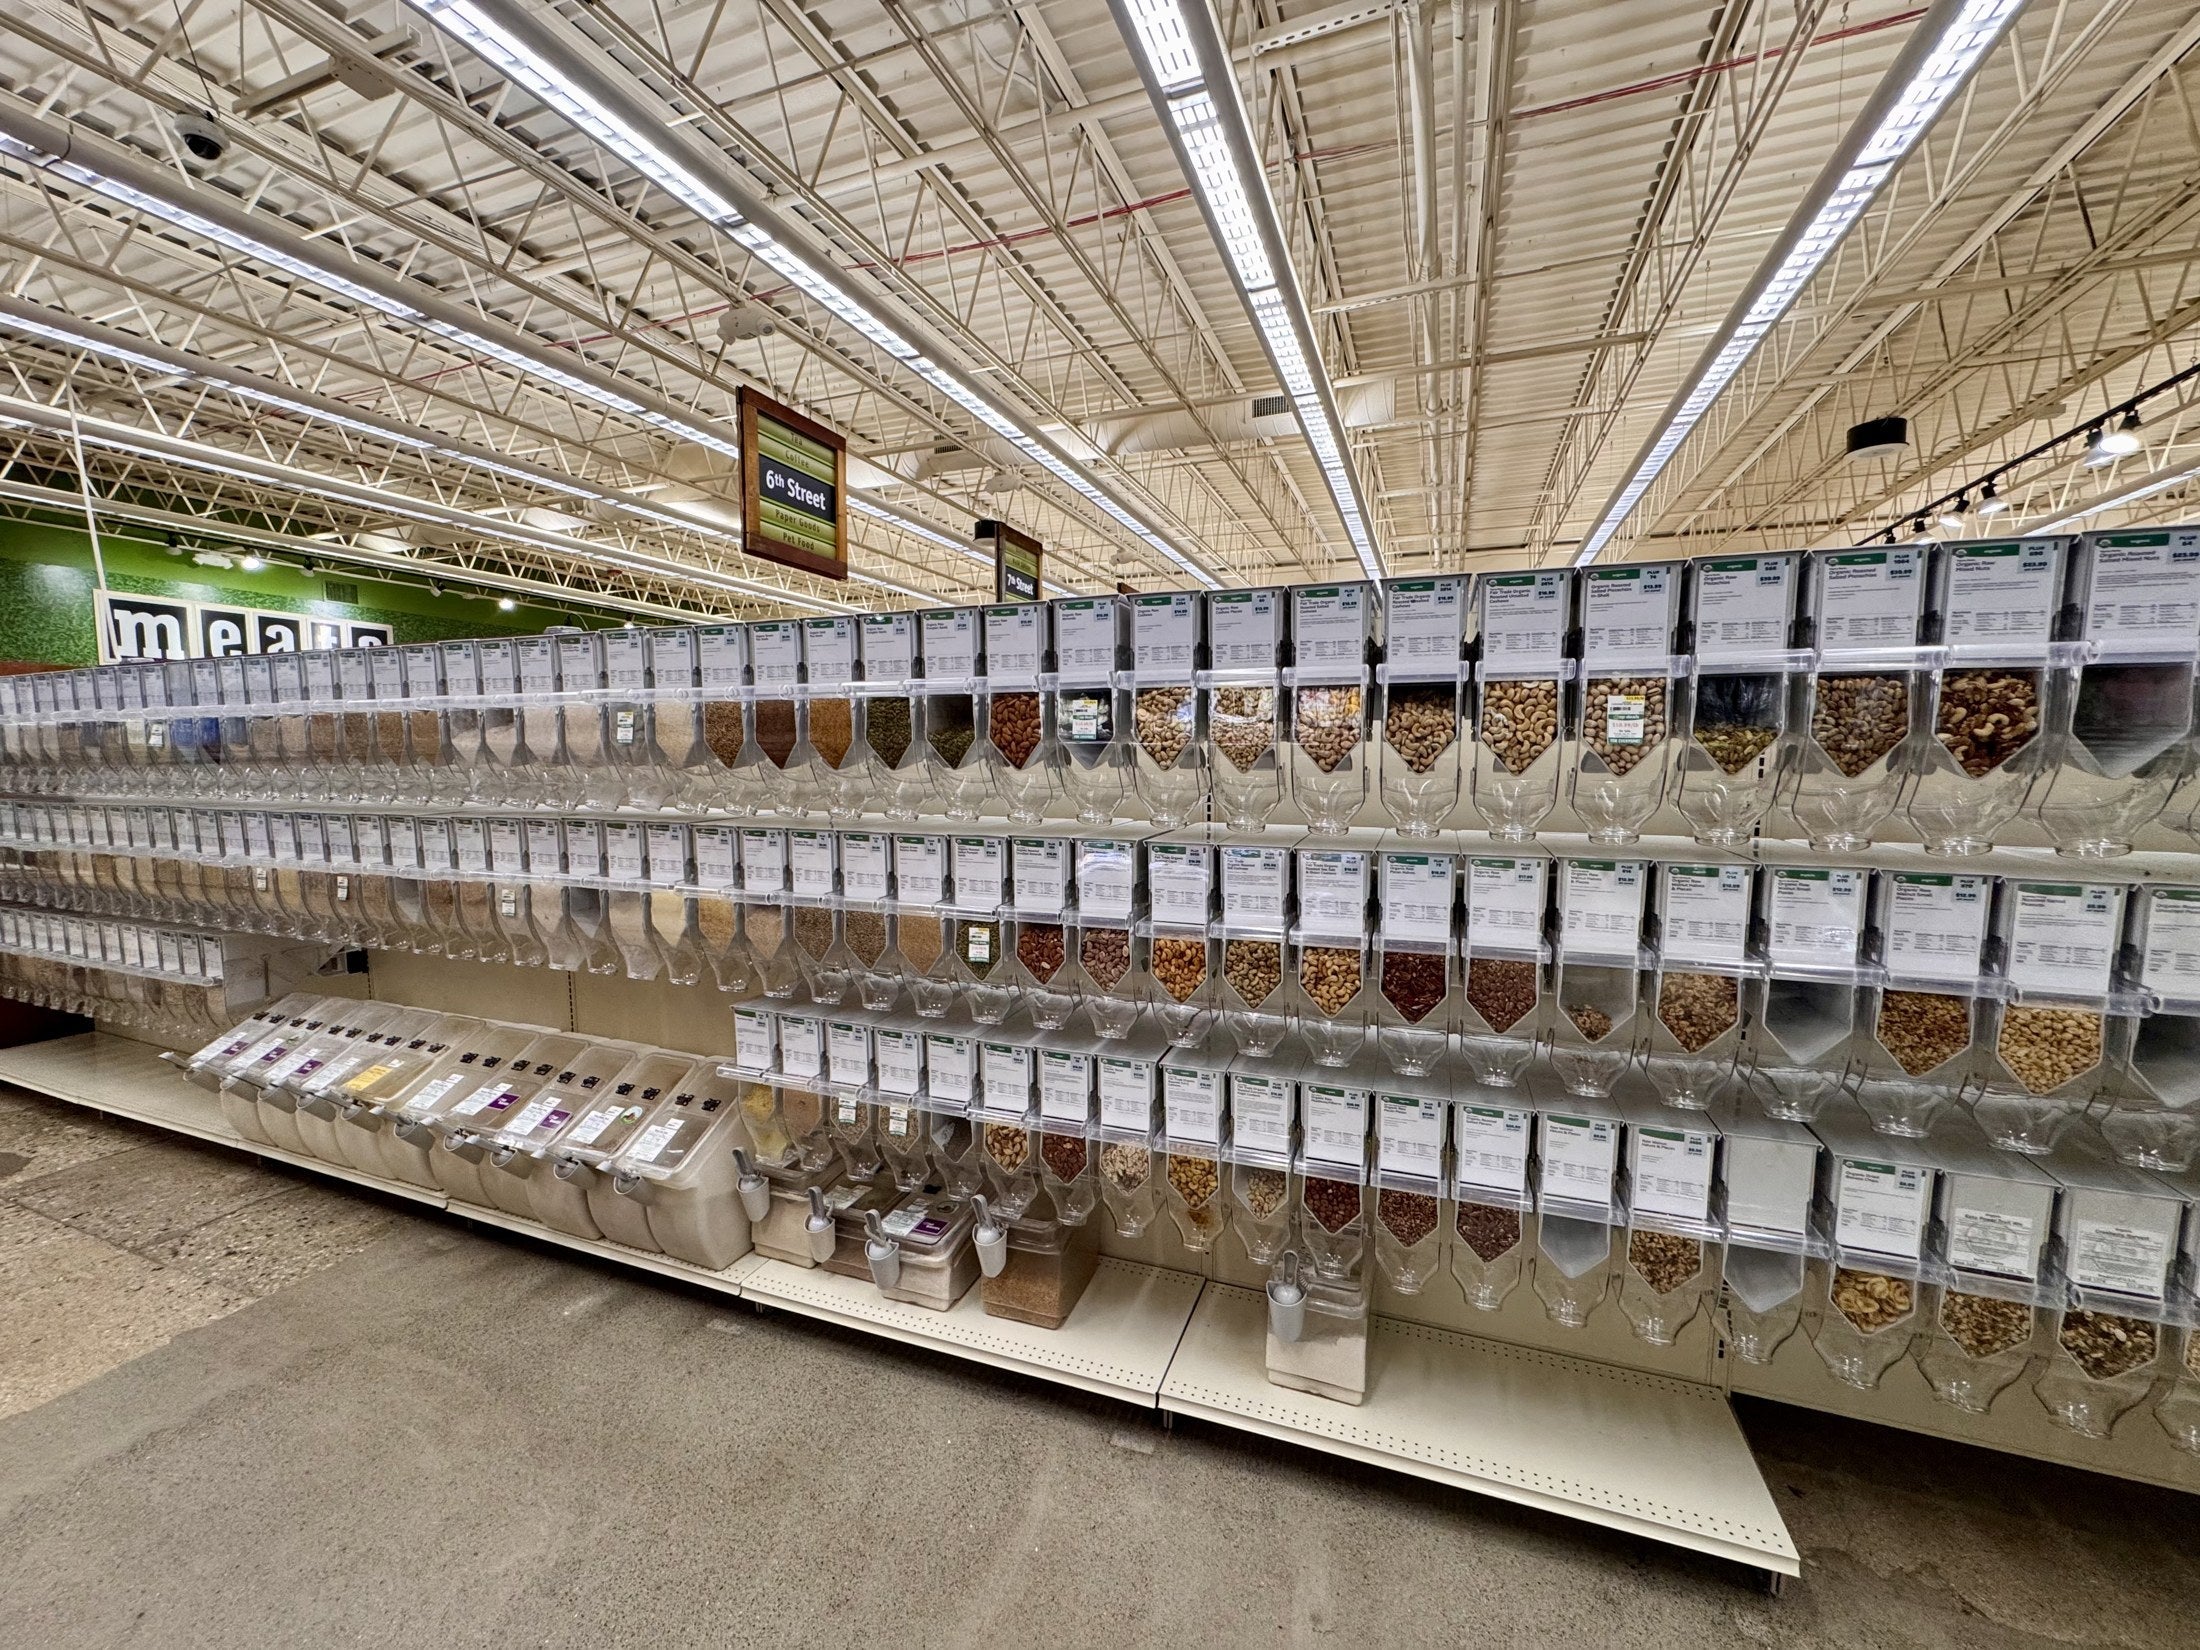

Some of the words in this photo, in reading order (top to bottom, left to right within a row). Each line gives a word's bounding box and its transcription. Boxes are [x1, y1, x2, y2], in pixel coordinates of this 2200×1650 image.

[790, 432, 803, 446] Tea
[785, 450, 810, 469] Coffee
[766, 469, 785, 490] 6th
[787, 477, 827, 511] Street
[775, 511, 797, 527] Paper
[799, 519, 821, 535] Goods
[783, 534, 796, 548] Pet
[798, 538, 815, 553] Food
[1007, 573, 1016, 587] 7th
[1016, 576, 1034, 596] Street
